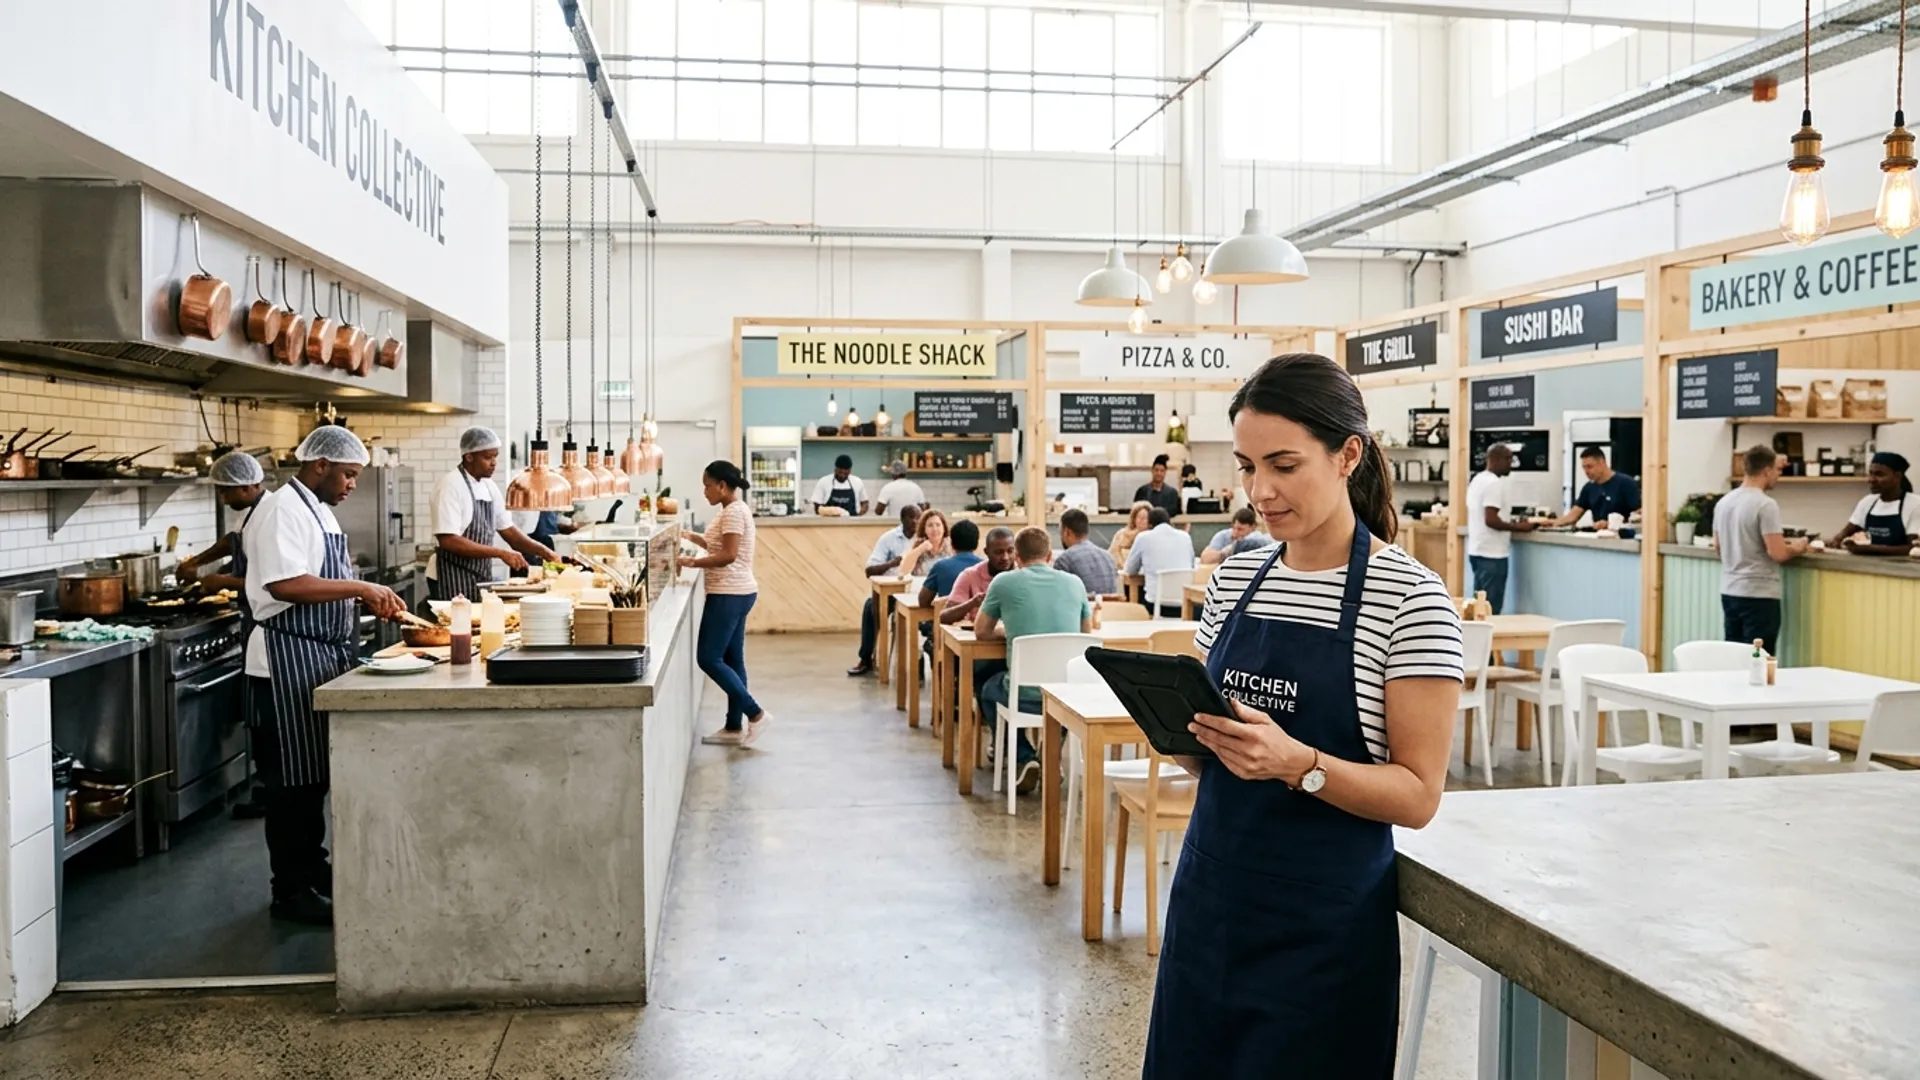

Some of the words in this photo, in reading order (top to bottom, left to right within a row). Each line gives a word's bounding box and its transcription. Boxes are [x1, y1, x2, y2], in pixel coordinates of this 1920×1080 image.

[210, 0, 337, 169] KITCHEN
[345, 95, 445, 246] COLLECTIVE
[1702, 268, 1786, 314] BAKERY
[1793, 264, 1810, 300] &
[1819, 244, 1919, 296] COFFEE
[1504, 310, 1548, 344] SUSHI
[1551, 304, 1584, 337] BAR
[789, 341, 827, 364] THE
[834, 342, 912, 365] NOODLE
[919, 343, 985, 366] SHACK
[1122, 346, 1176, 367] PIZZA
[1182, 347, 1195, 368] &
[1201, 347, 1230, 369] CO.
[1222, 668, 1298, 698] KITCHEN
